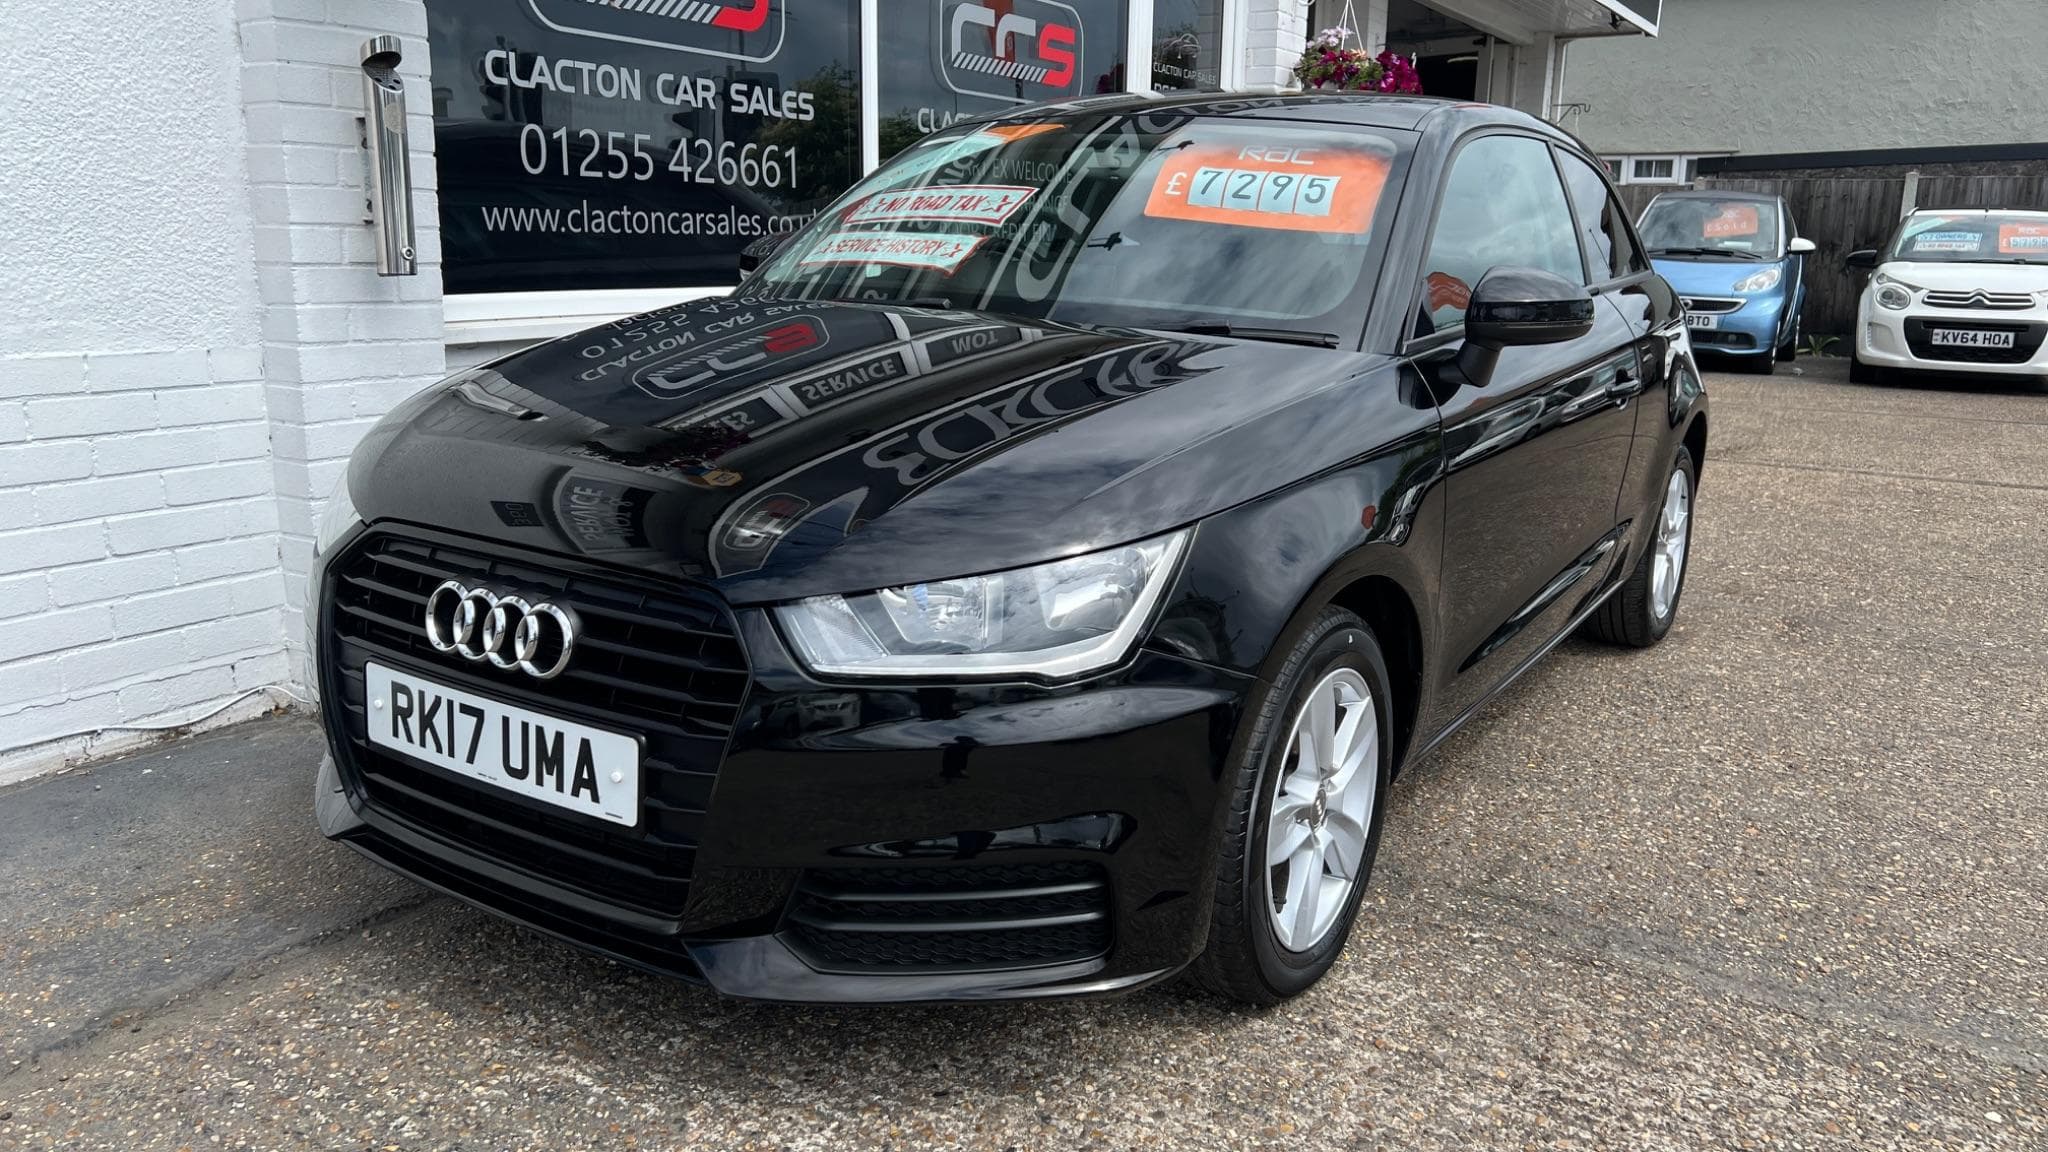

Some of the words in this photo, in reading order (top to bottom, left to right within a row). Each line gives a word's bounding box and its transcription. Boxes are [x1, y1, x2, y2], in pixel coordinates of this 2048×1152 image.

[484, 49, 640, 101] CLACTON
[655, 73, 716, 110] CAR
[729, 82, 815, 121] SALES
[519, 123, 655, 182] 01255
[668, 137, 797, 189] 426661
[481, 200, 817, 237] www.clactoncarsales.co
[882, 196, 908, 213] NO
[911, 195, 954, 212] ROAD
[949, 195, 989, 211] TAX
[835, 238, 882, 254] SERVICE
[885, 240, 945, 256] HISTORY
[1941, 331, 1978, 345] KV64
[1982, 332, 2010, 346] HOA
[390, 679, 485, 766] RK17
[501, 715, 601, 804] UMA
